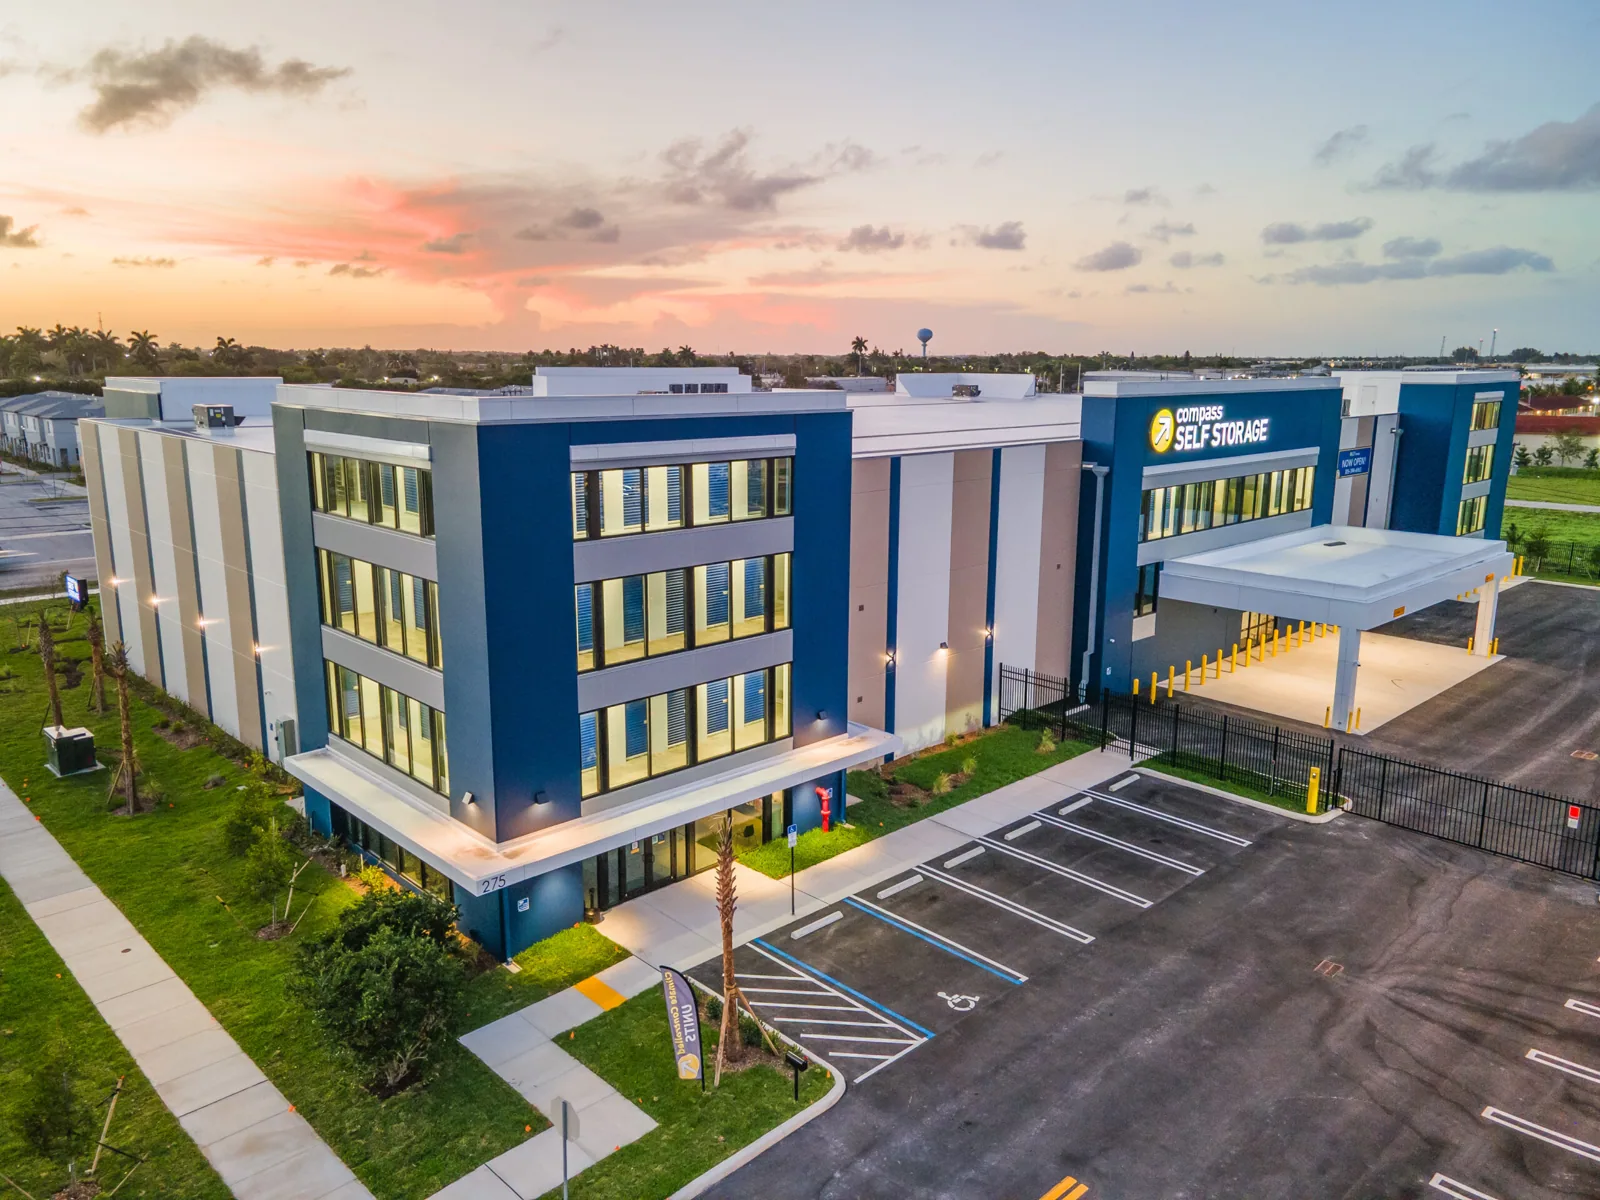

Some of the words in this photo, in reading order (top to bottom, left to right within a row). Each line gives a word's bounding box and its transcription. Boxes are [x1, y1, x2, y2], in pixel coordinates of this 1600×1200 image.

[1176, 405, 1224, 426] compass
[1174, 424, 1211, 450] SELF
[1211, 418, 1269, 446] STORAGE
[1341, 458, 1354, 468] NOW
[482, 874, 506, 893] 275
